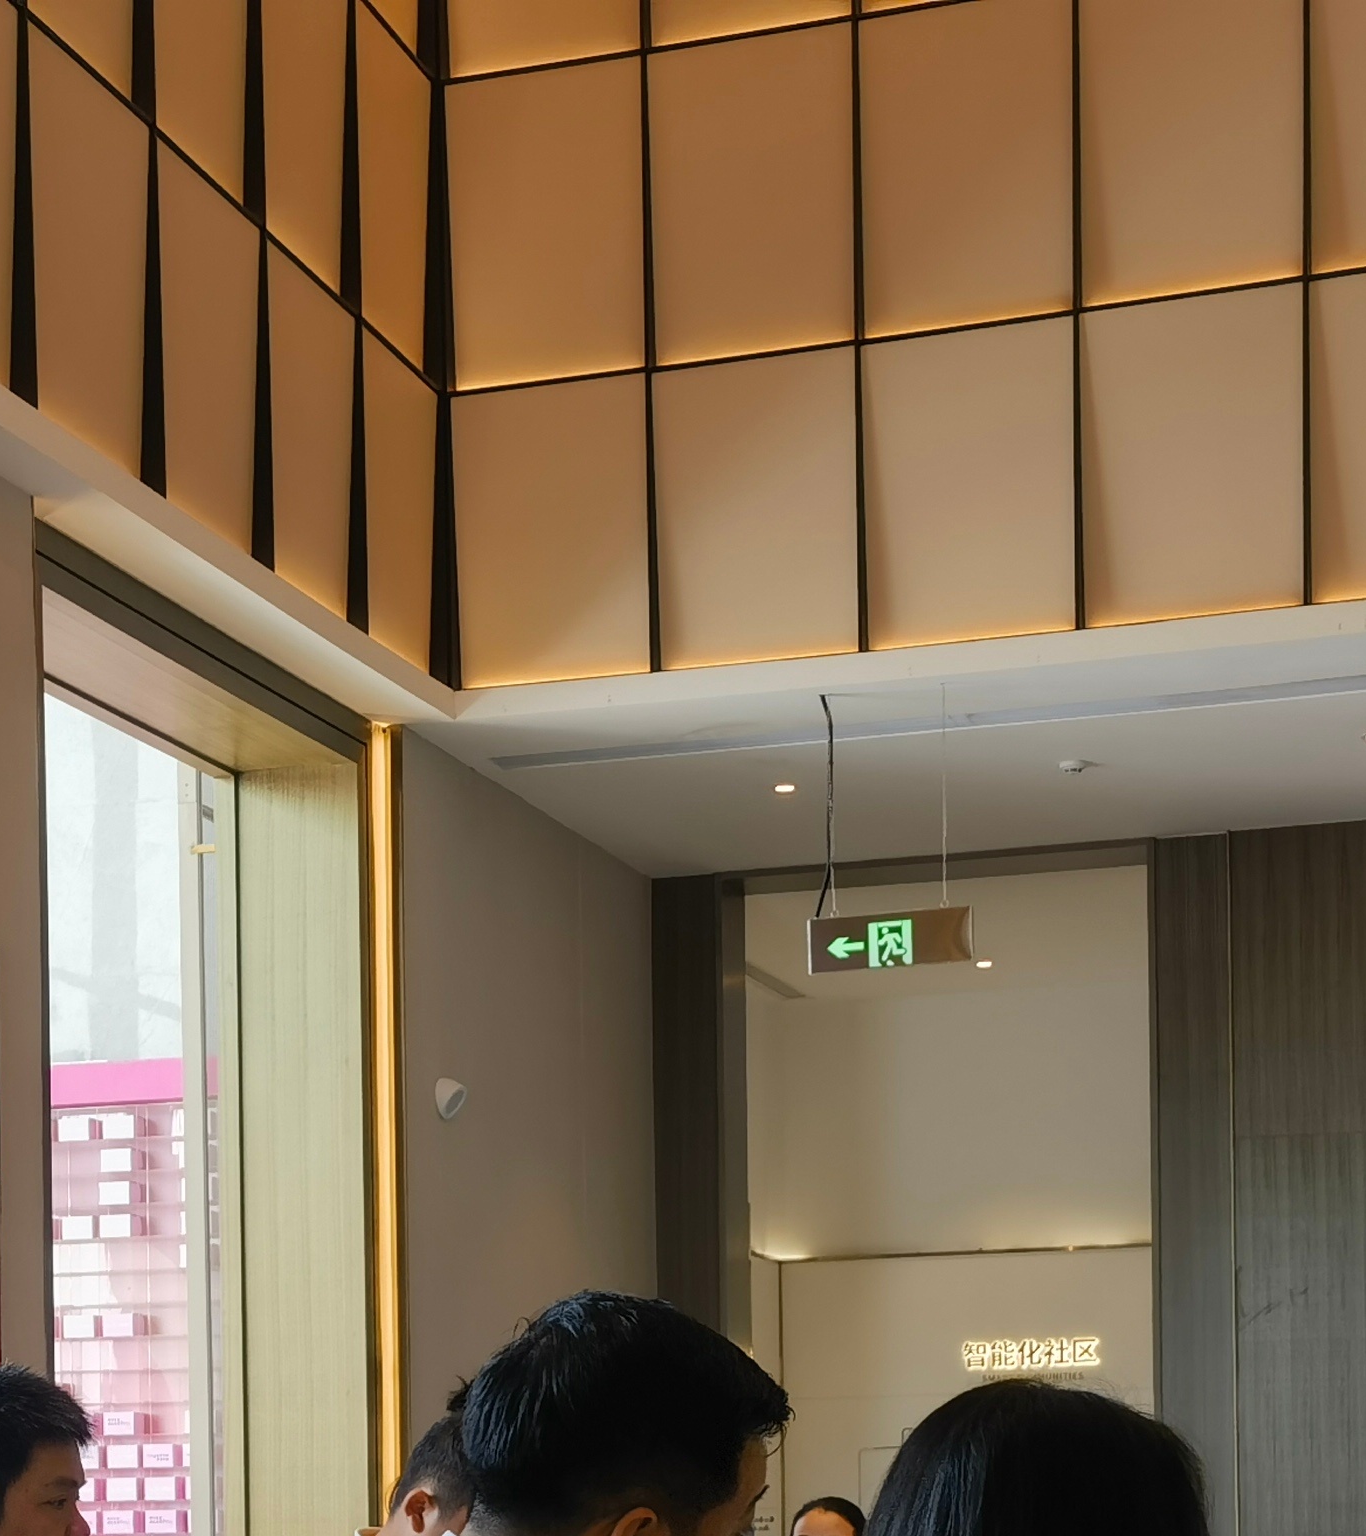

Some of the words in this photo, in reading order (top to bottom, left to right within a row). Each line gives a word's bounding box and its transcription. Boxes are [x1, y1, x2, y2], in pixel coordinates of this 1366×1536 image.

[964, 1338, 1099, 1368] 智能化社区
